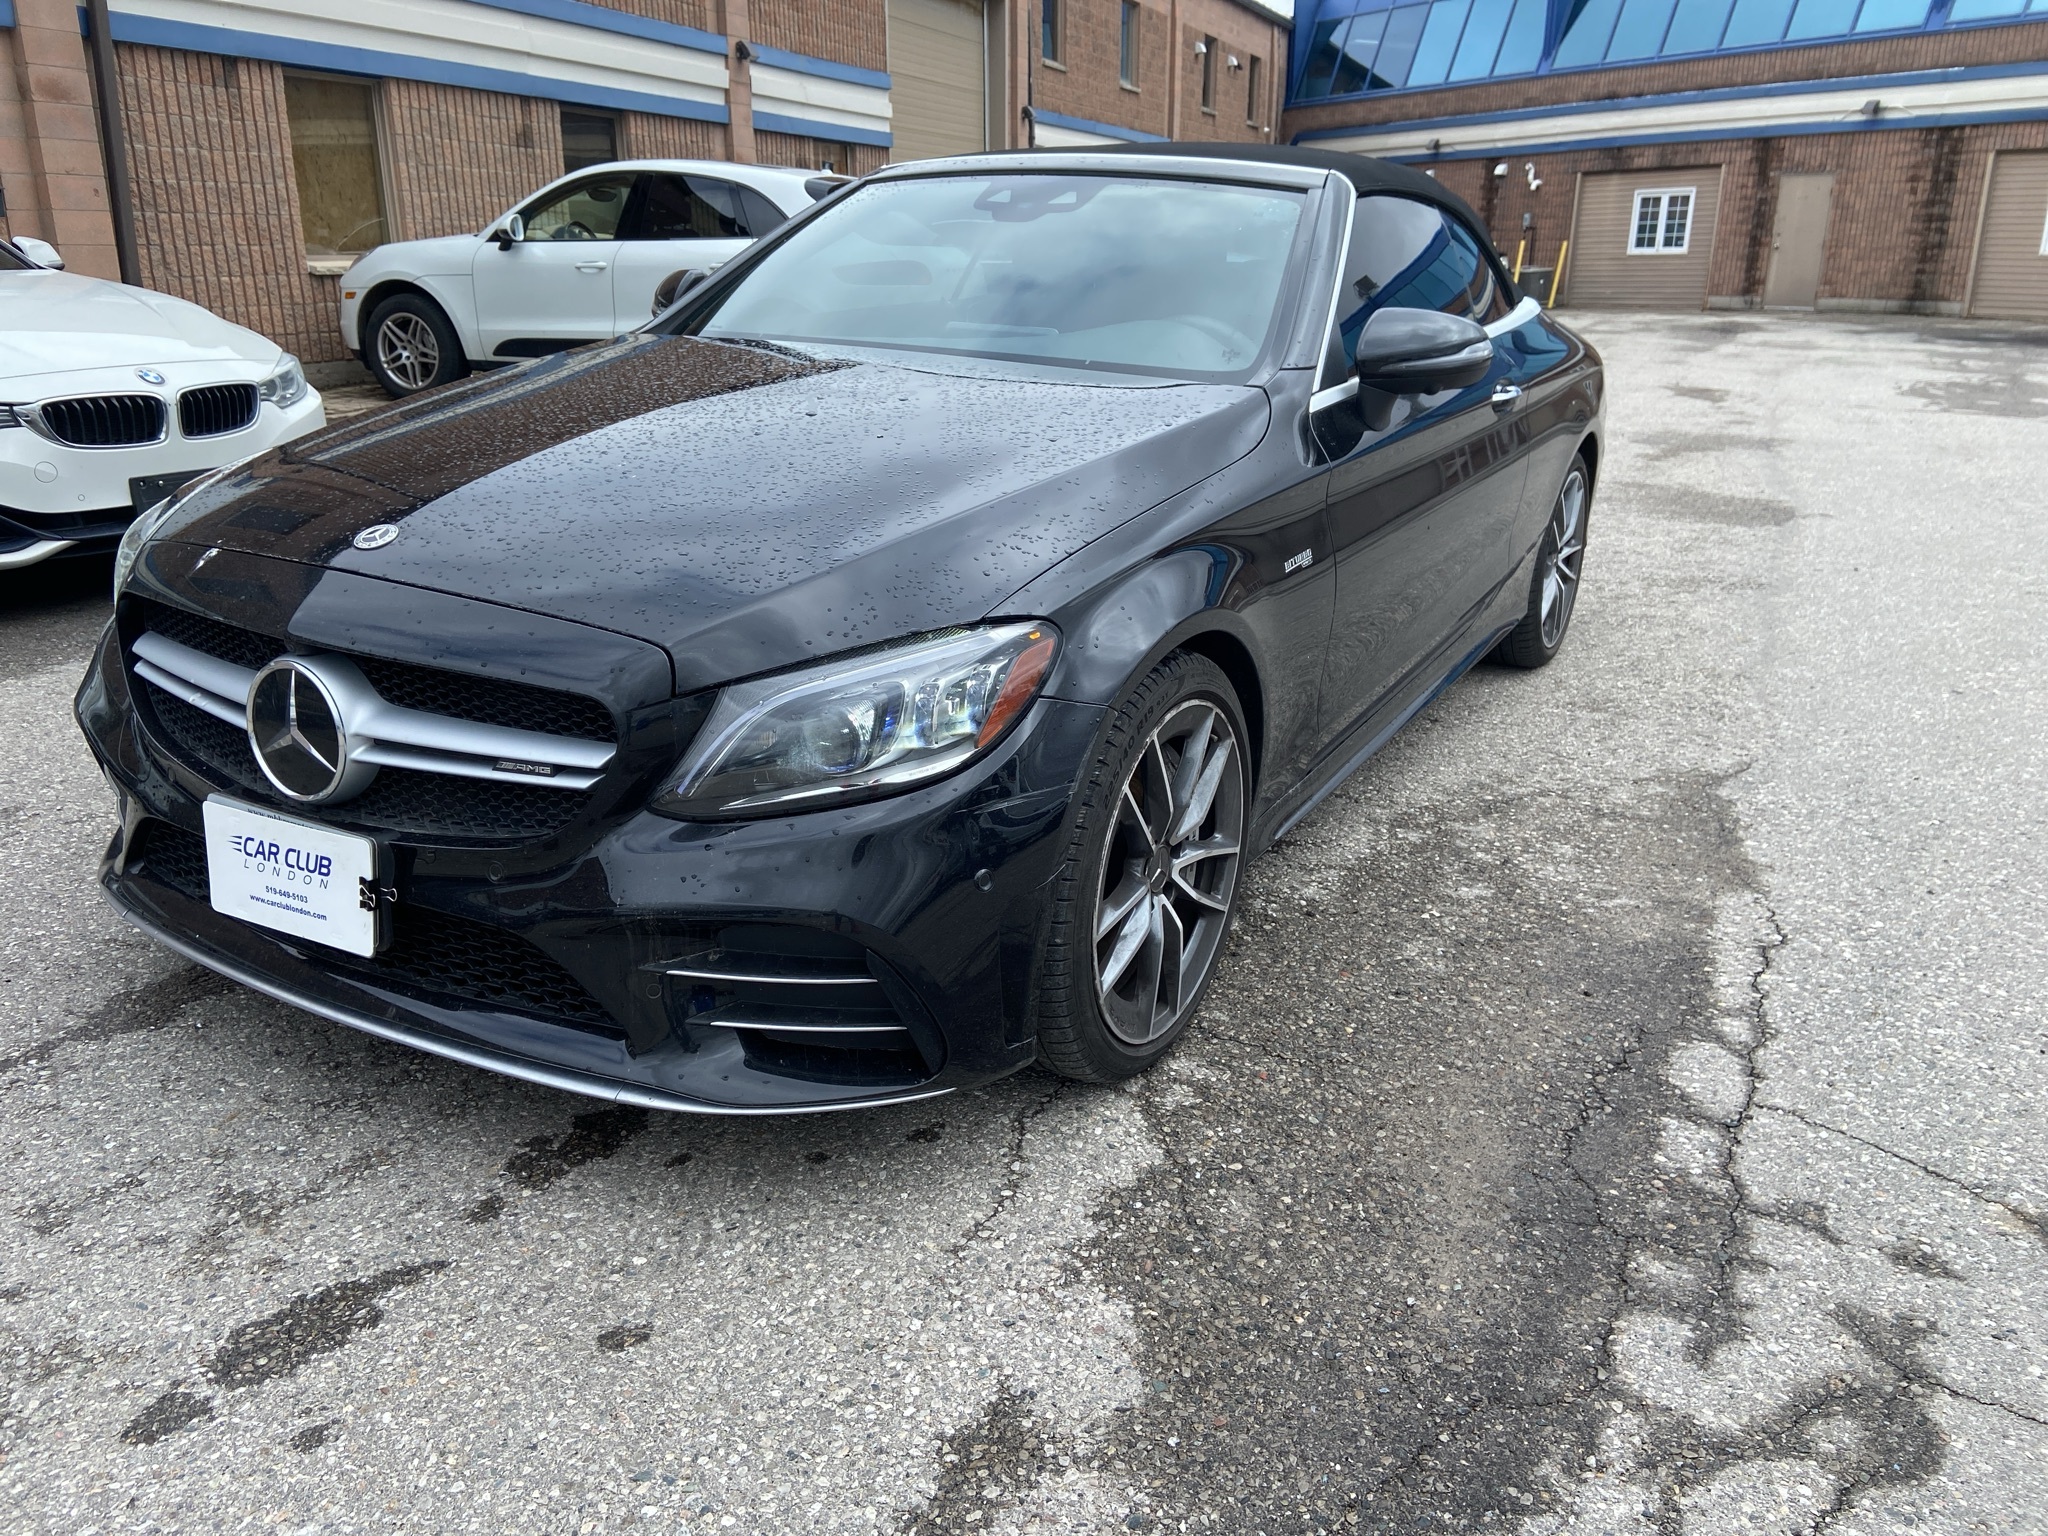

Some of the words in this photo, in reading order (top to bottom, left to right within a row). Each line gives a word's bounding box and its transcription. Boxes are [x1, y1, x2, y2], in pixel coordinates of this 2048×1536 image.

[513, 763, 551, 775] AMG
[1103, 735, 1135, 811] 225/40
[1136, 705, 1154, 736] R19
[243, 836, 280, 865] CAR
[284, 847, 332, 877] CLUB
[243, 858, 329, 890] LONDON
[249, 893, 327, 921] www.carclublondon.com
[265, 885, 308, 904] 519-649-5103
